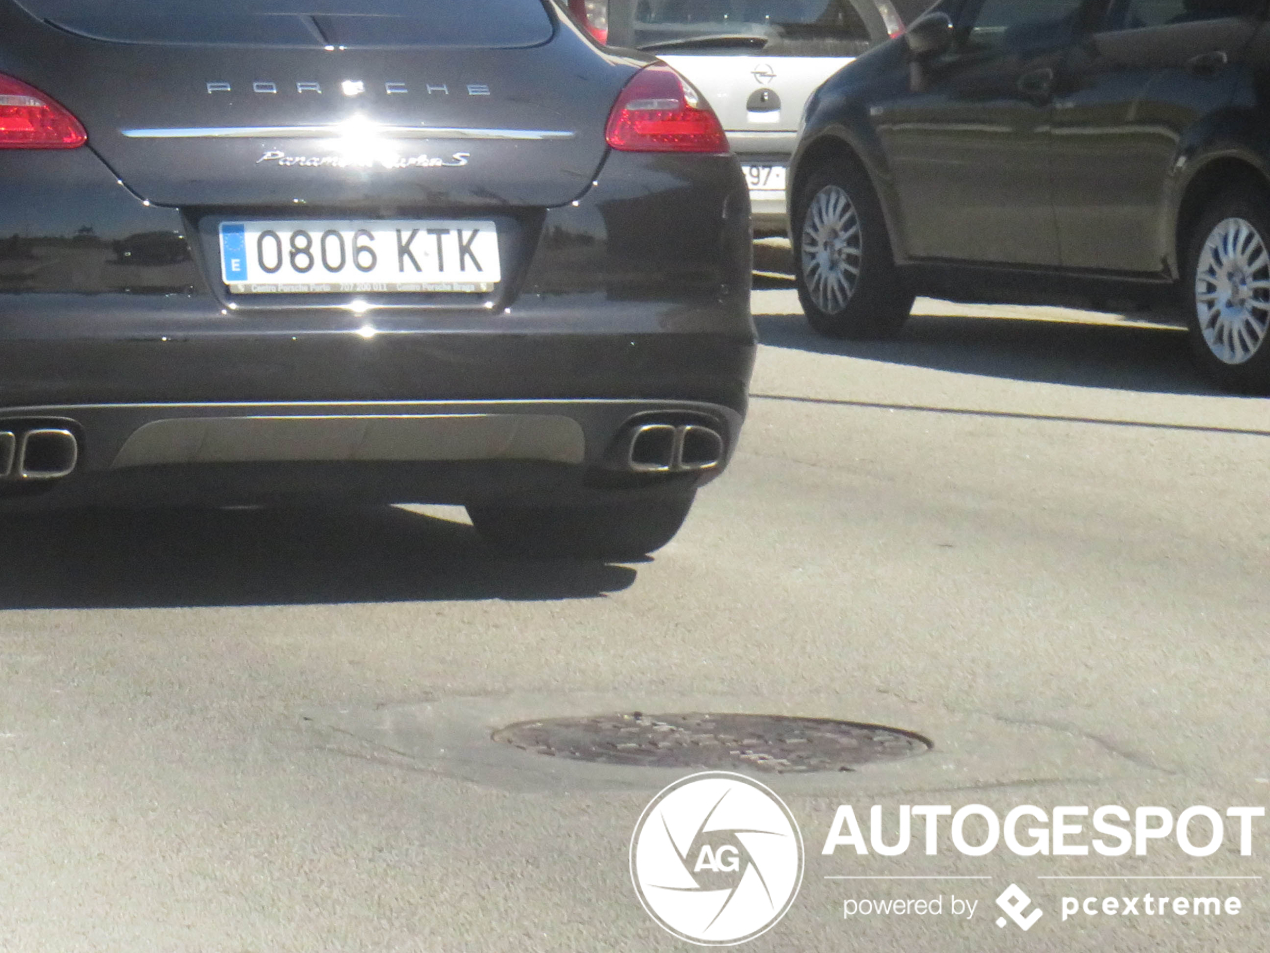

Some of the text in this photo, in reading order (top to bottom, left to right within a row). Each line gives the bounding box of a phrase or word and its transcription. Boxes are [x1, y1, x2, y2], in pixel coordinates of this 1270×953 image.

[443, 152, 470, 167] S
[257, 228, 484, 274] 0806 KTK
[231, 258, 241, 271] E
